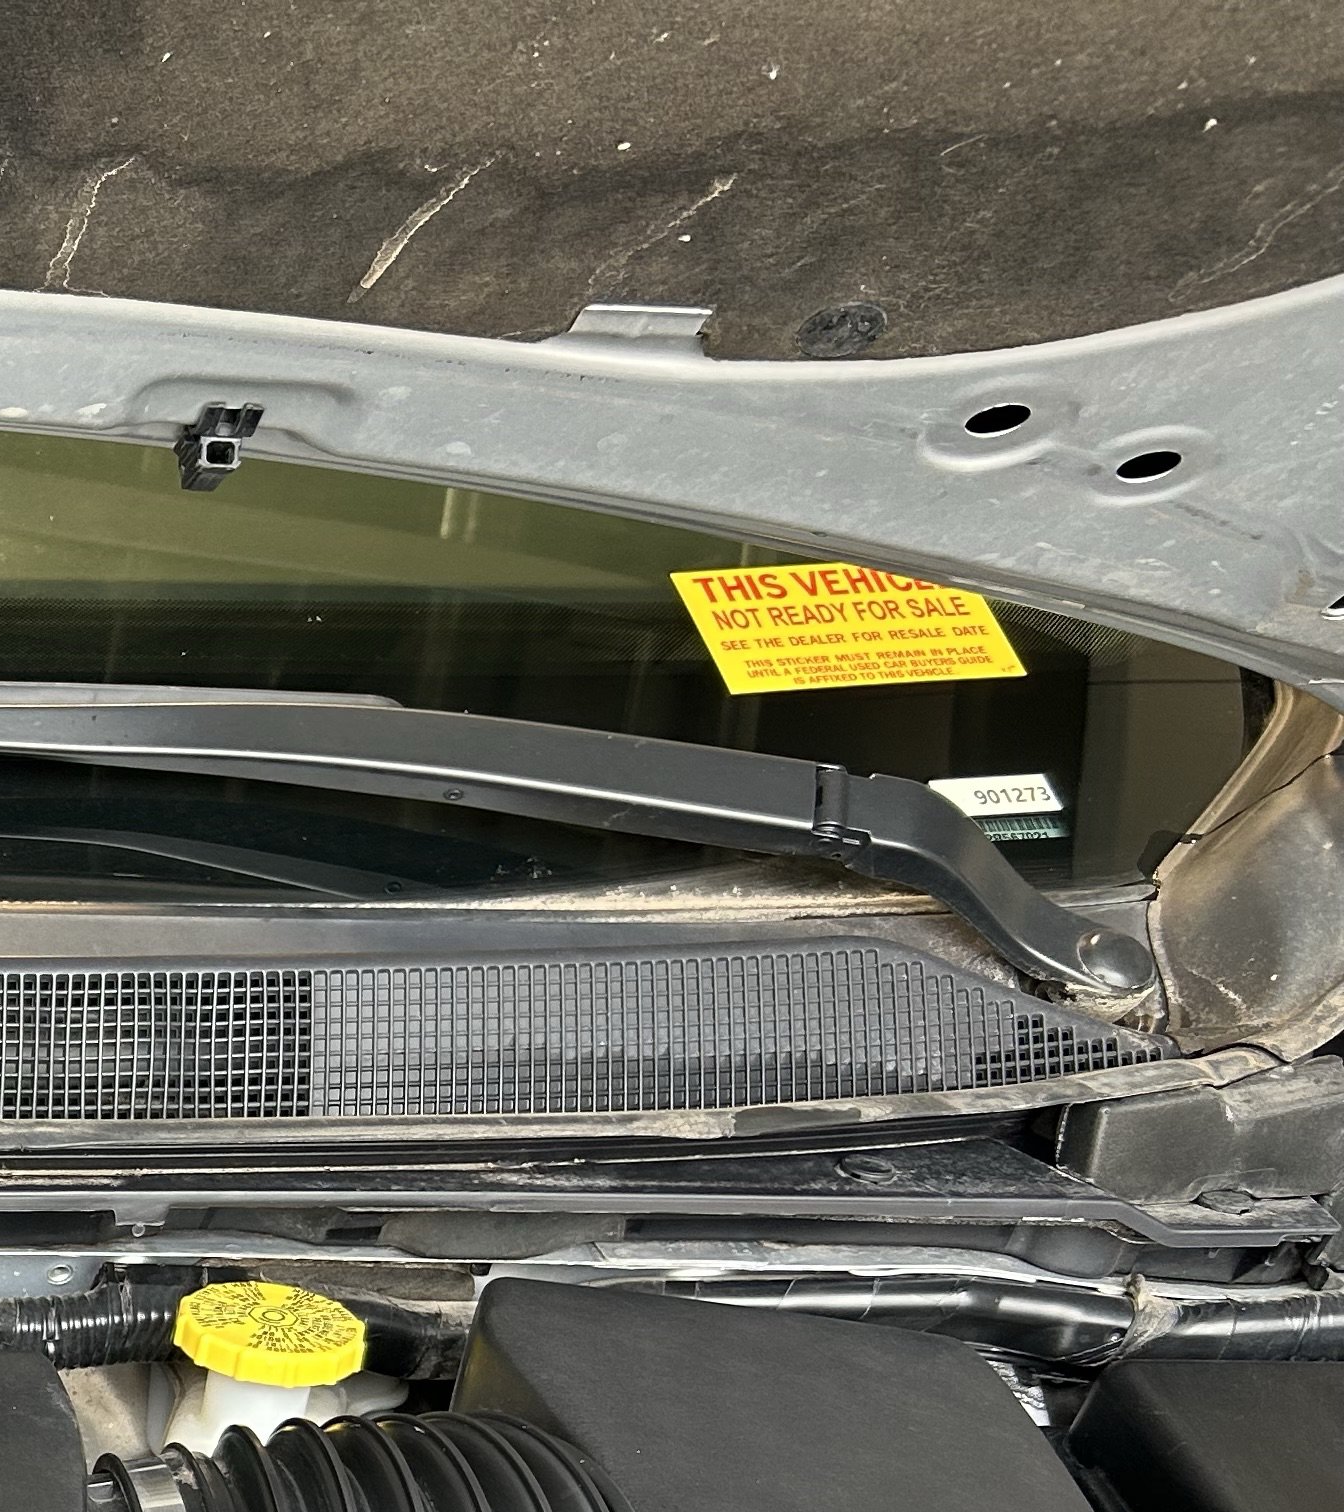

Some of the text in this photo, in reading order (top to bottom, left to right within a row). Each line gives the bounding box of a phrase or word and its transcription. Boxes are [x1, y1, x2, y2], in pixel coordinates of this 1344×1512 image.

[692, 568, 946, 603] THIS VEHICL
[712, 596, 971, 631] NOT READY FOR SALE
[720, 625, 990, 651] SEE THE DEALER FOR RESALE DATE
[744, 645, 988, 669] THIS STICKER MUST REMAIN IN PLACE
[747, 655, 994, 678] UNTIL A FEDERAL USED CAR BUYERS GUIDE
[793, 676, 806, 685] IS
[809, 673, 858, 684] AFFIXED
[860, 671, 876, 680] TO
[879, 669, 905, 679] THIS
[974, 786, 1052, 805] 901273
